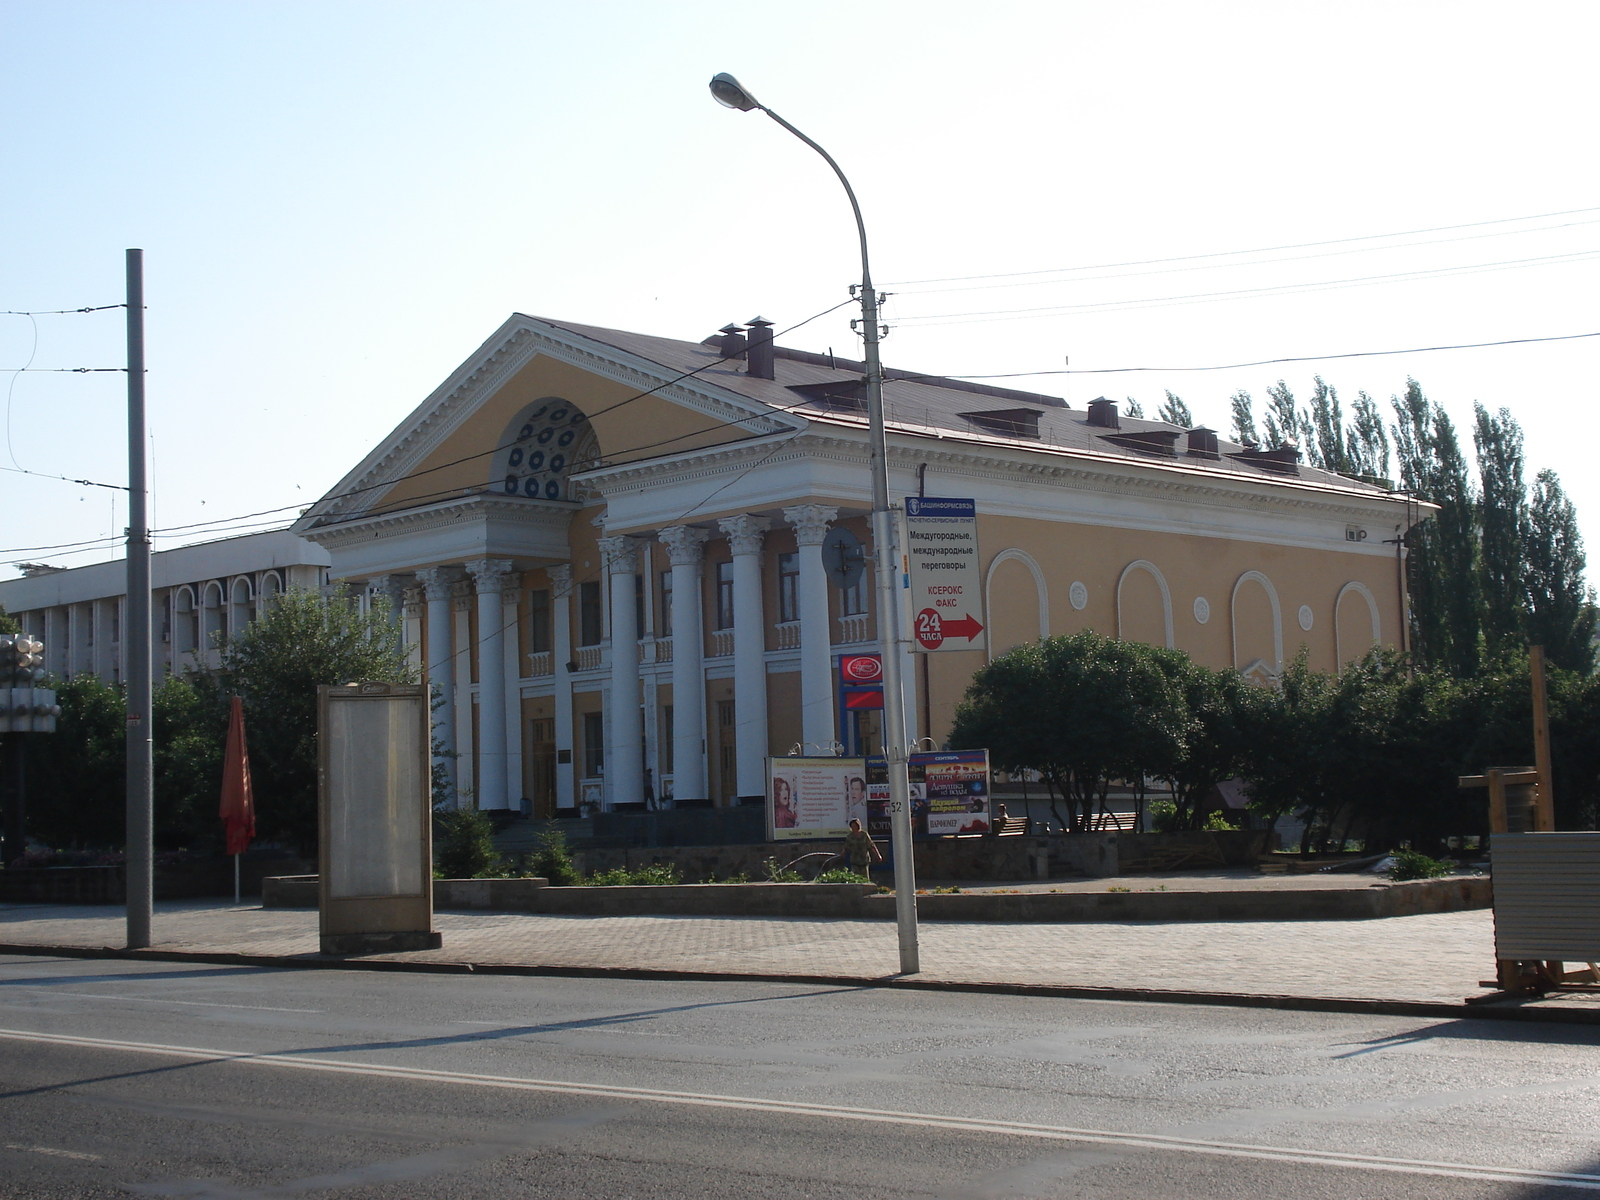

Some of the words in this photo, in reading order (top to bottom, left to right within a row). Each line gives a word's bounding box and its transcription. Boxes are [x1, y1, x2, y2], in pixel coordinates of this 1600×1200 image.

[909, 530, 972, 541] Междугородные,
[913, 547, 973, 556] международные
[921, 562, 966, 571] переговоры
[928, 586, 963, 595] КСЕРОКС
[936, 599, 957, 607] ФАКС
[919, 613, 941, 632] 24
[920, 632, 942, 640] ЧАСА
[891, 801, 902, 813] 52
